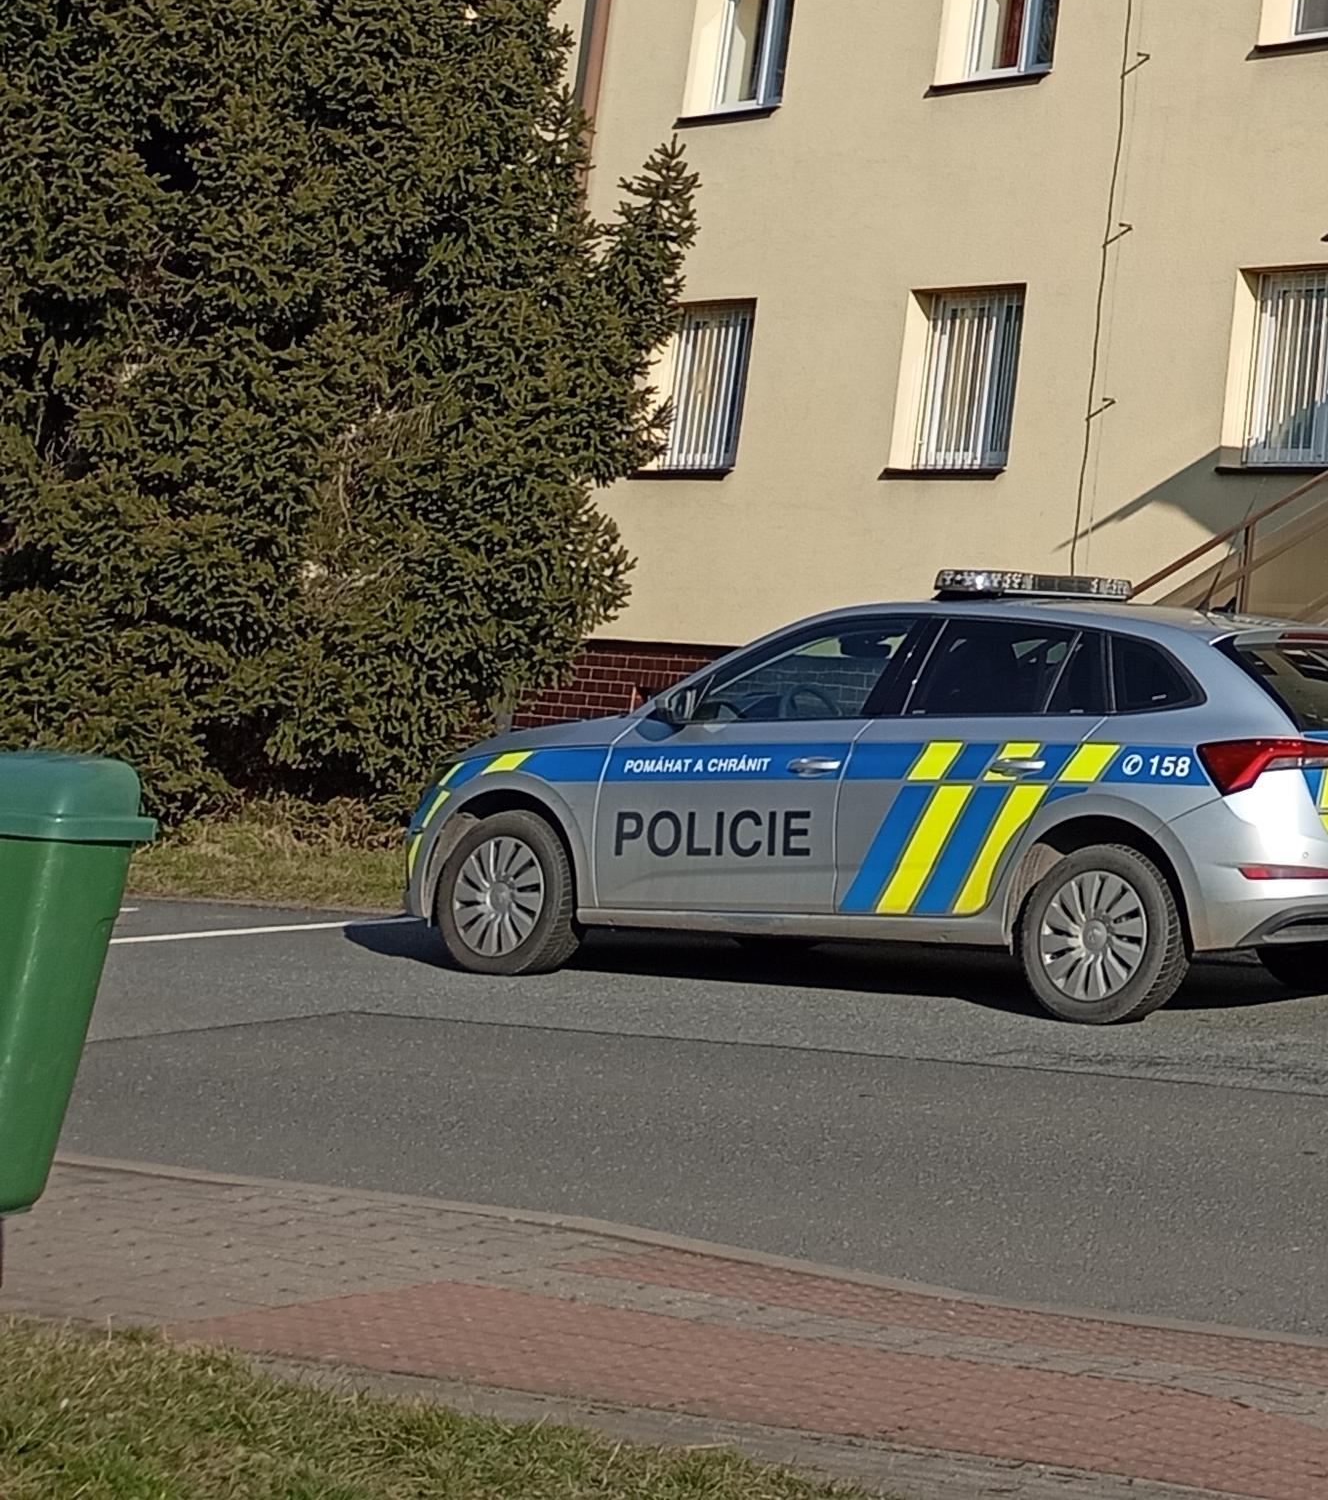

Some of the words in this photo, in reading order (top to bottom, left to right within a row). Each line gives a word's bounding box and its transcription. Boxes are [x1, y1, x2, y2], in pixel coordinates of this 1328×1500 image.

[624, 756, 693, 773] POMÁHAT
[693, 758, 703, 772] A
[707, 754, 772, 773] CHRÁNIT
[1149, 755, 1191, 777] 158
[614, 809, 812, 857] POLICIE
